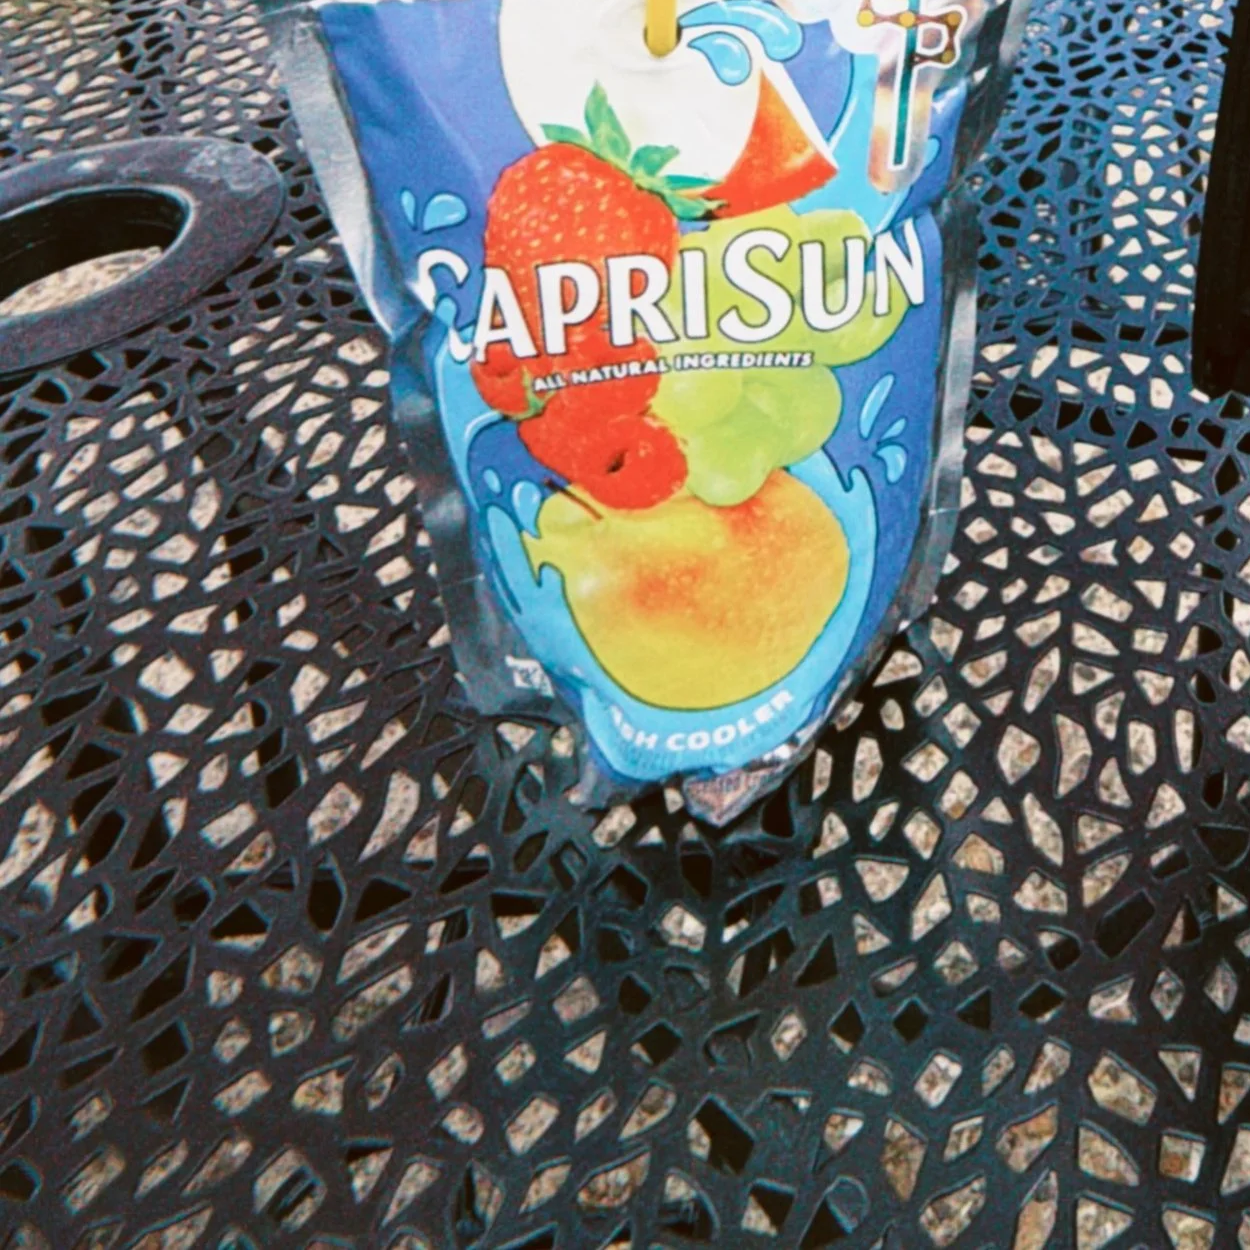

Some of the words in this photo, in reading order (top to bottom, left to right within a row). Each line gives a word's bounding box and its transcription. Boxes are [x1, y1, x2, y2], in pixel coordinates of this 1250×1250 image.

[533, 377, 567, 393] ALL
[571, 358, 669, 386] NATURAL
[673, 351, 815, 371] INGREDIENTS
[666, 689, 794, 751] COOLER
